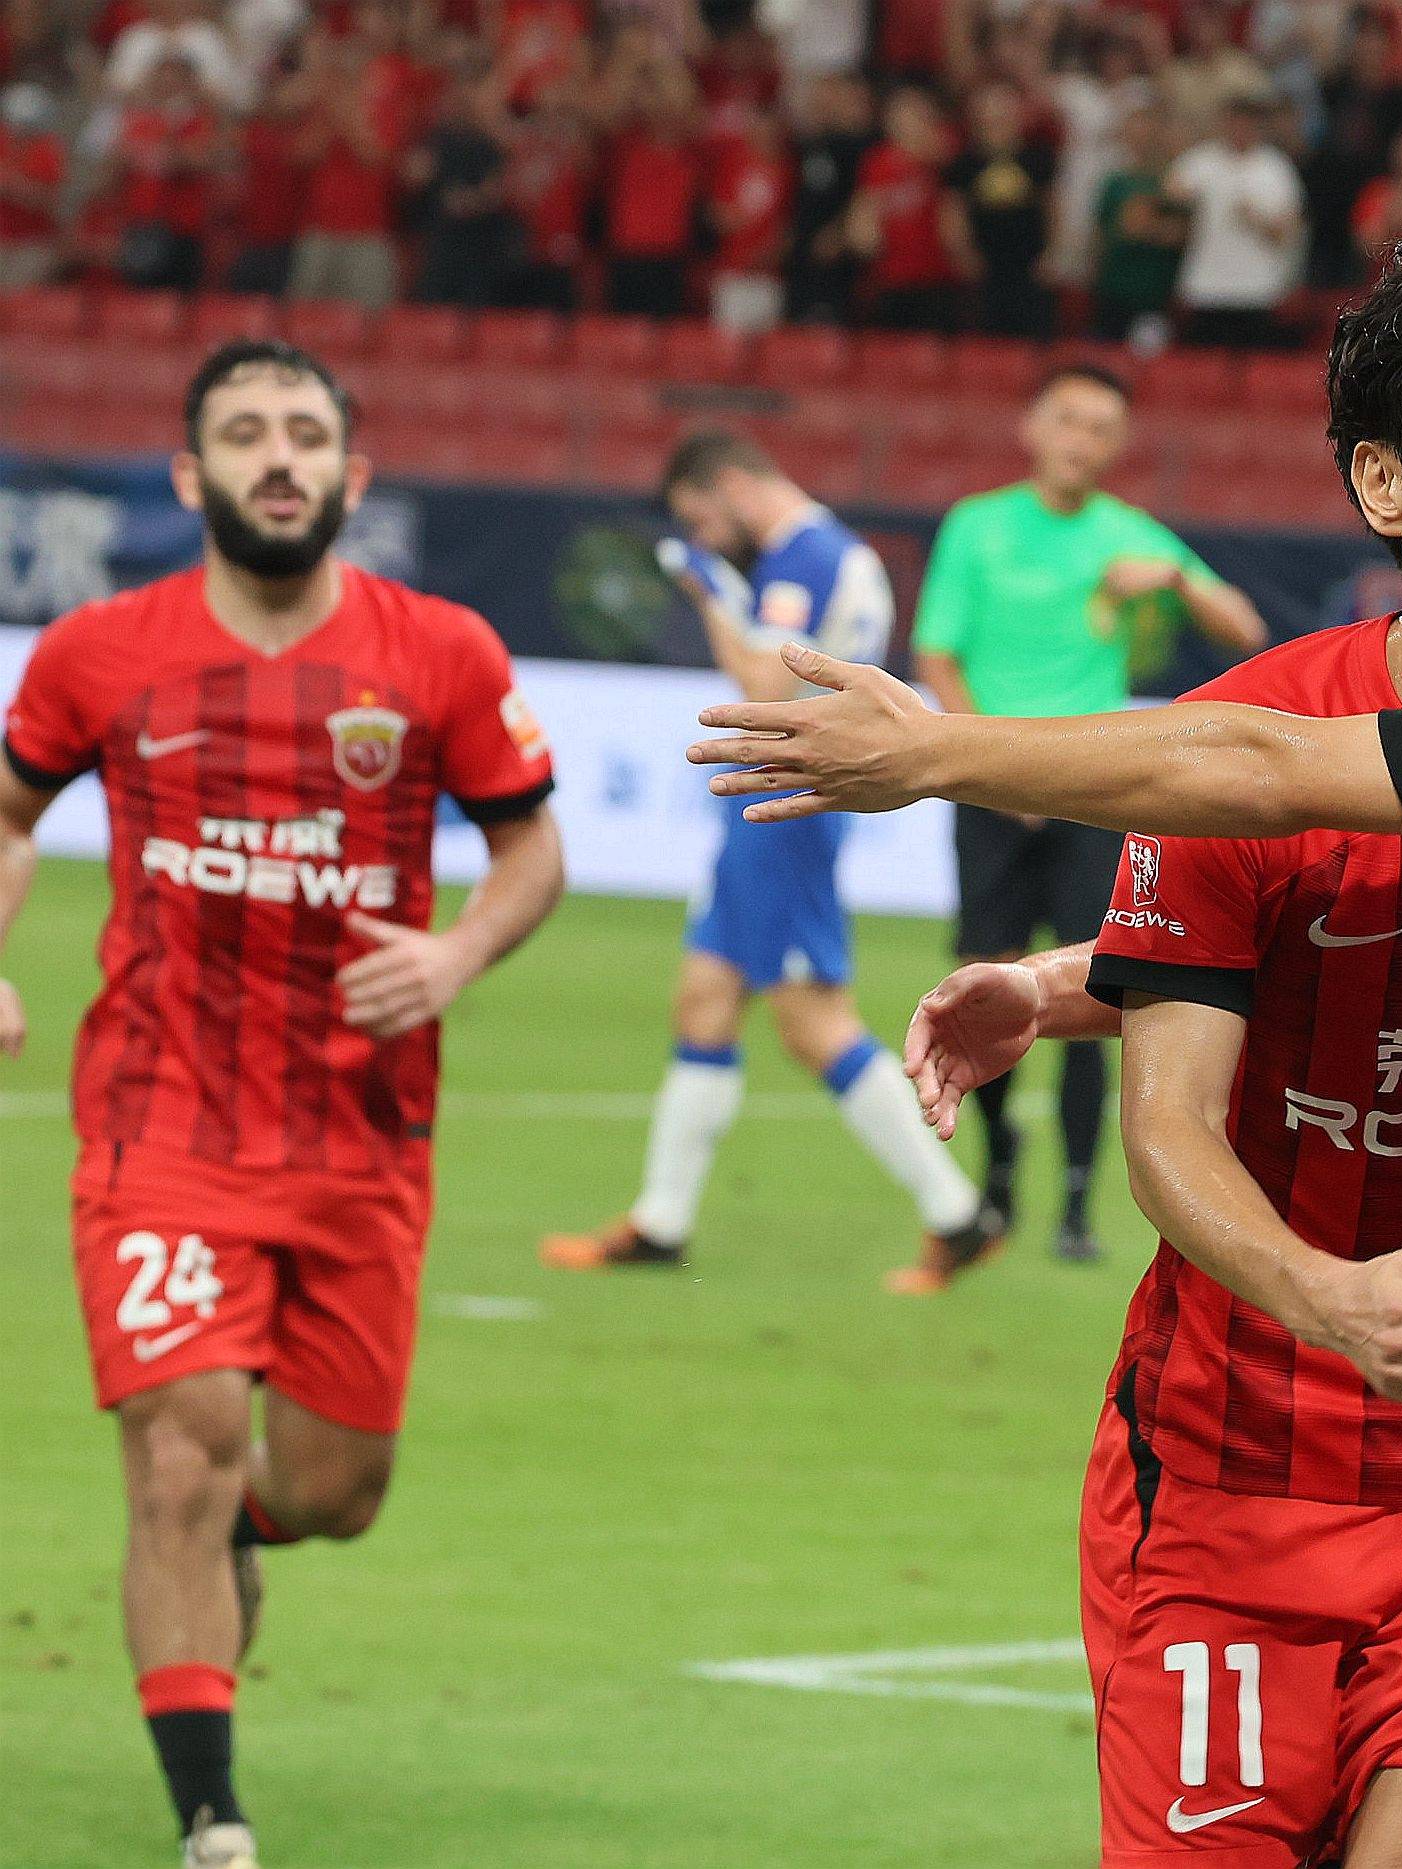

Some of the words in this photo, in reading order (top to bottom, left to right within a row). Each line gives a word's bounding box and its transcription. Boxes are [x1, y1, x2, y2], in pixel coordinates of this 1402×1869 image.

[1102, 908, 1186, 937] ROEWE
[115, 1230, 226, 1333] 24
[1163, 1641, 1265, 1787] 11
